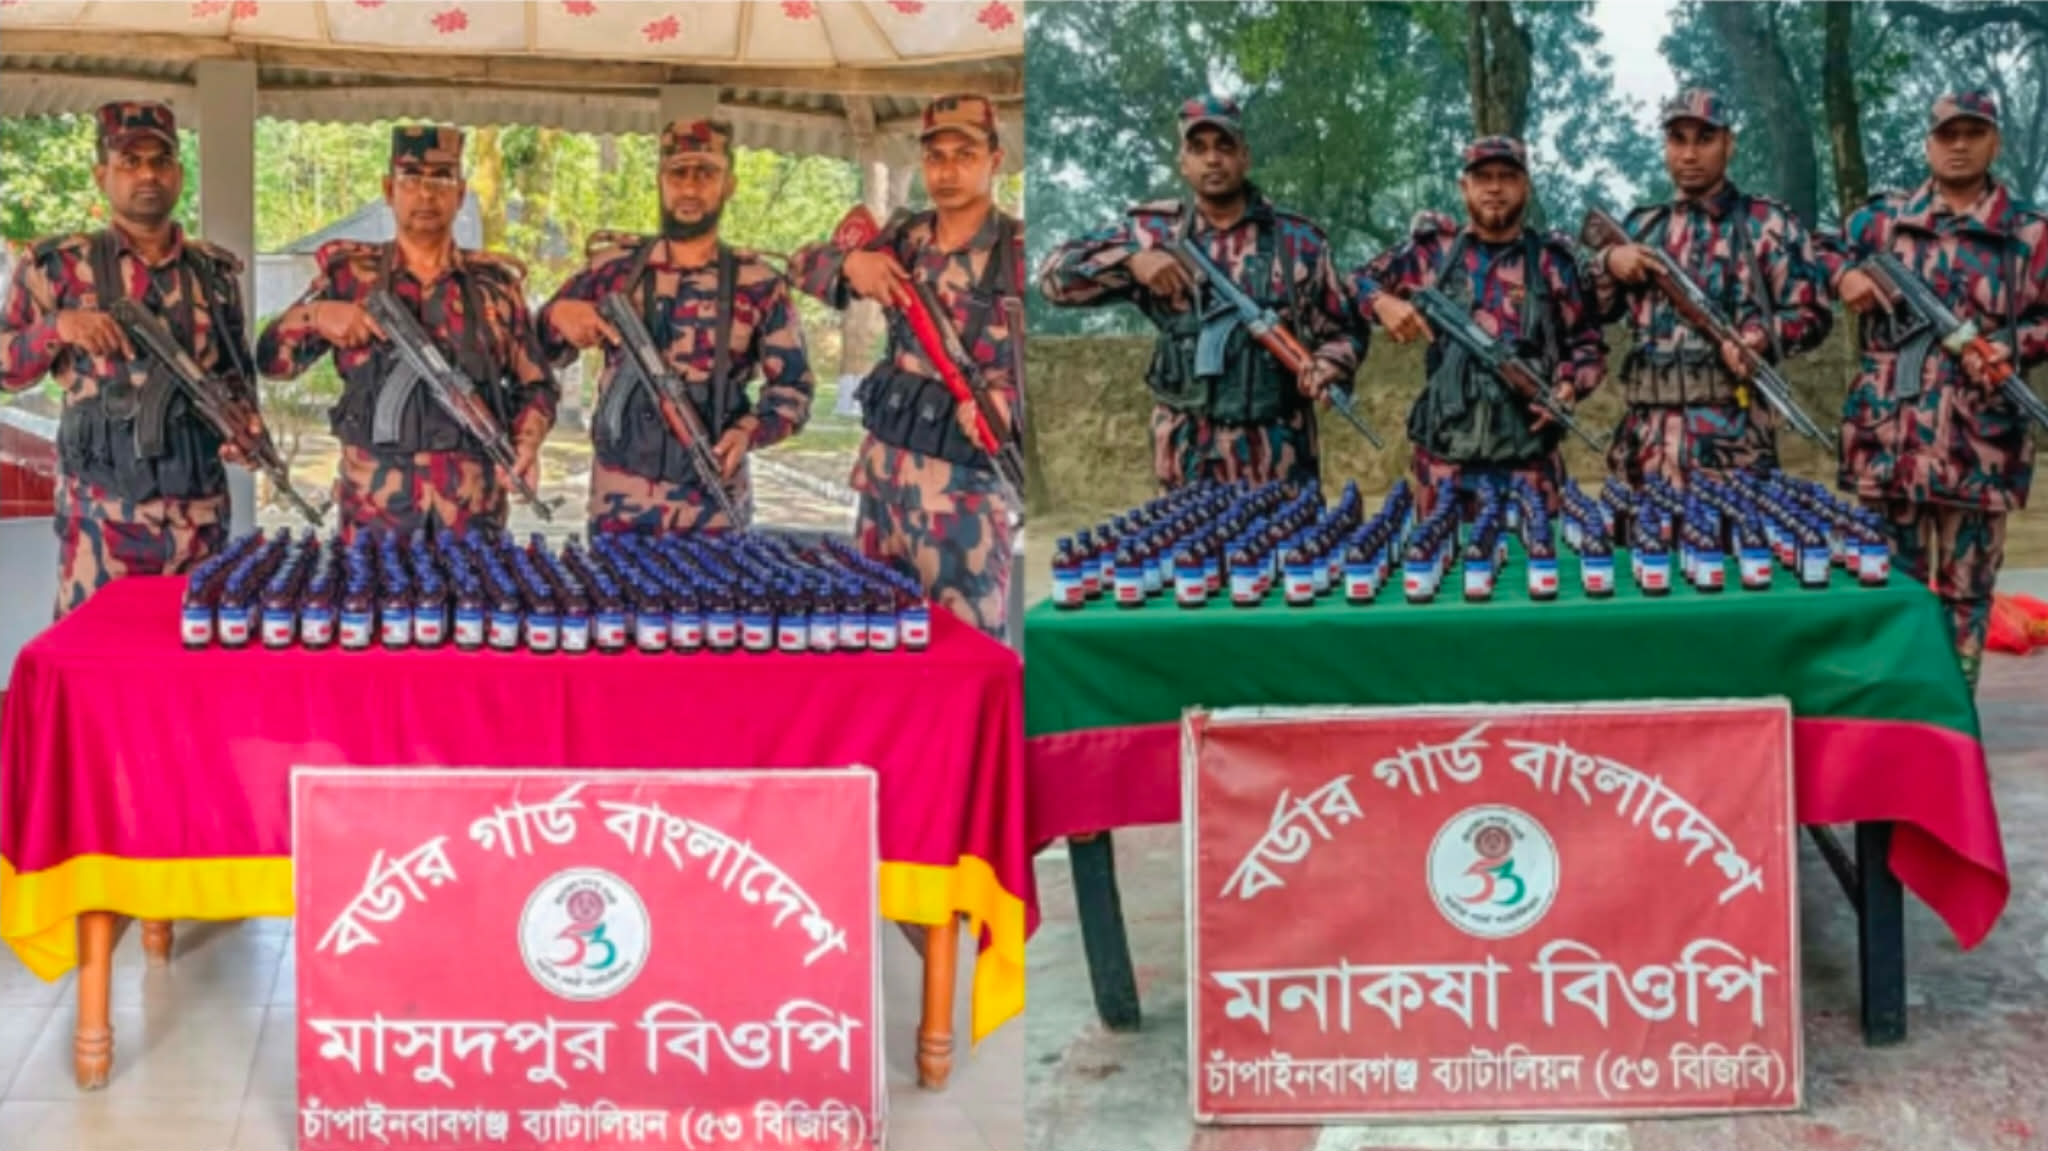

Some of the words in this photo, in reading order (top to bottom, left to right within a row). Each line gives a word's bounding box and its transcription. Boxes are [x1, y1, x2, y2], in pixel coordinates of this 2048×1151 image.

[1220, 774, 1364, 900] বর্ডার
[1373, 722, 1493, 796] গার্ড
[1503, 738, 1765, 904] বাংলাদেশ
[316, 836, 459, 956] বর্ডার
[469, 782, 589, 858] গার্ড
[598, 799, 847, 967] বাংলাদেশ
[1212, 954, 1511, 1033] মনাকষা
[1531, 938, 1776, 1028] বিওপি
[308, 1012, 614, 1088] মাসুদপুর
[636, 999, 861, 1074] বিওপি
[1205, 1048, 1420, 1099] চাঁপাইনবাবগঞ্জ
[1430, 1043, 1584, 1094] ব্যাটালিয়ন
[1594, 1049, 1660, 1101] (৫৩
[1669, 1041, 1787, 1098] বিজিবি)
[300, 1096, 510, 1144] চাঁপাইনবাবগঞ্জ
[519, 1097, 669, 1142] ব্যাটালিয়ন
[680, 1106, 743, 1149] (৫৩
[753, 1098, 866, 1150] বিজিবি)
